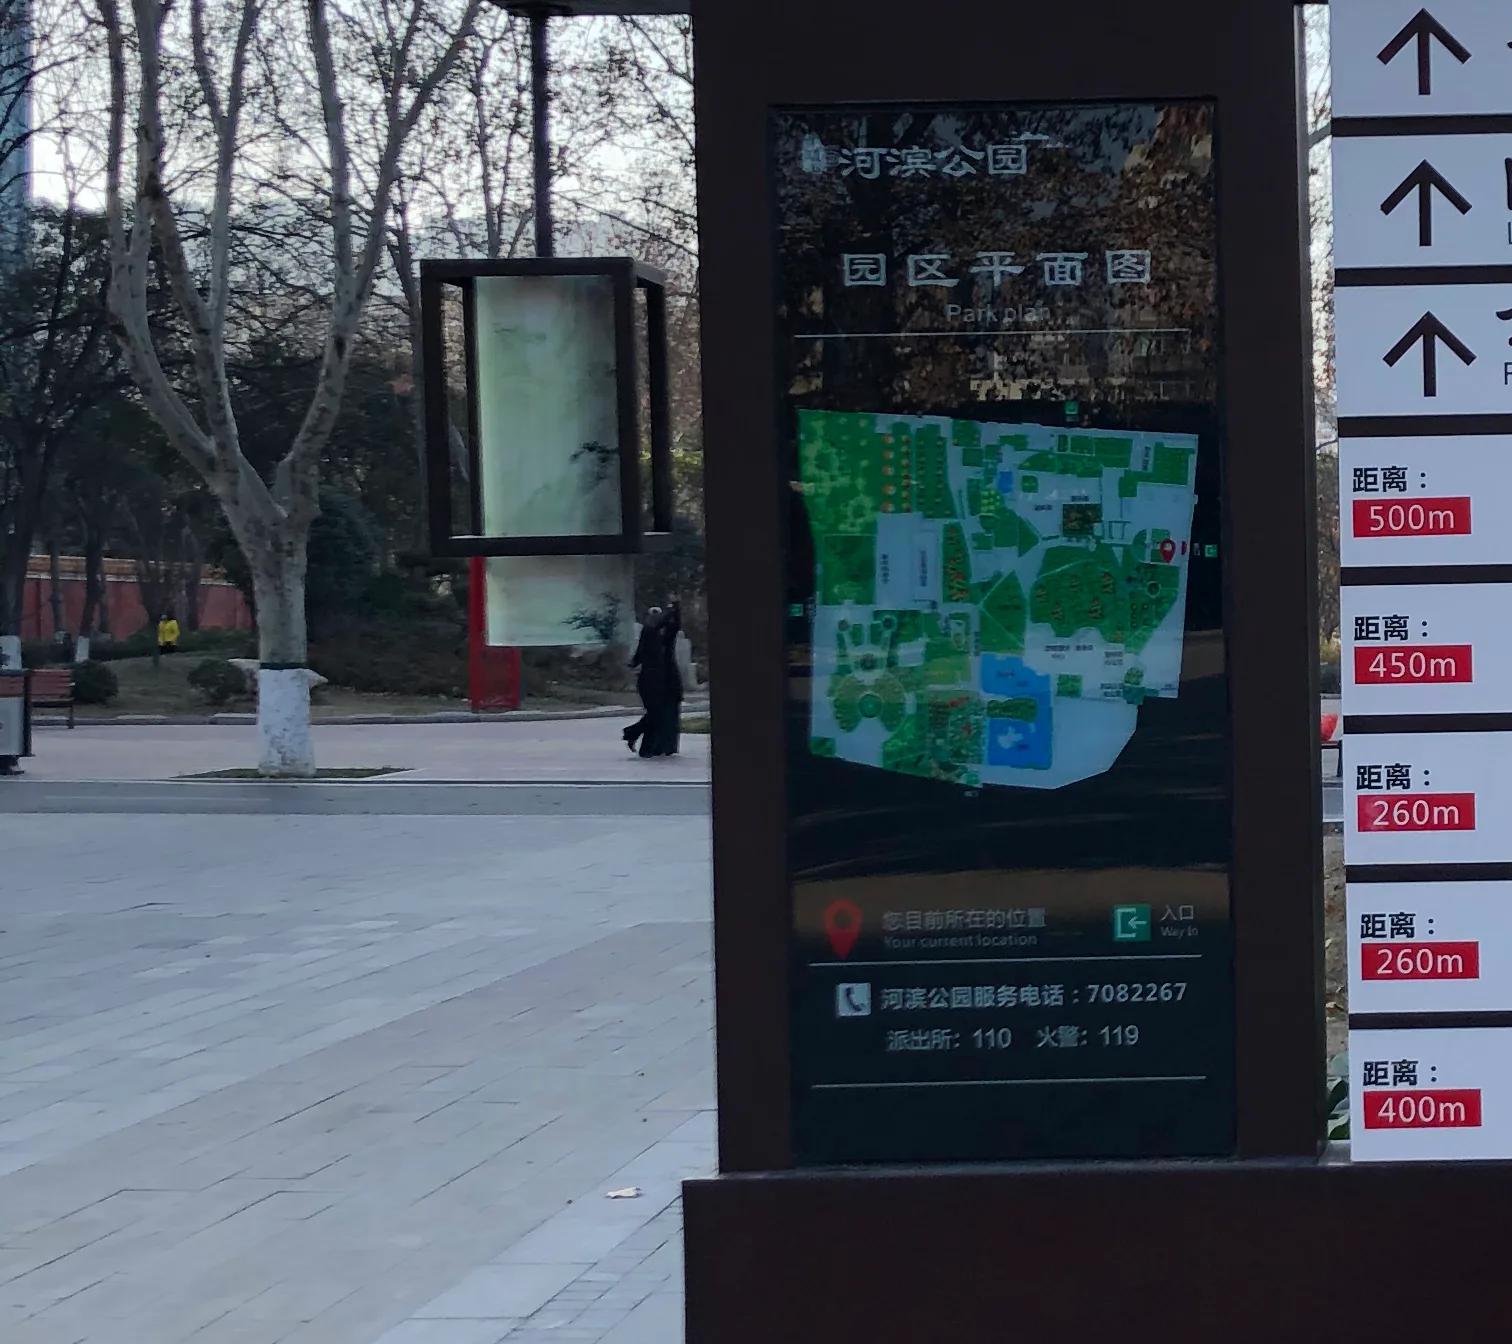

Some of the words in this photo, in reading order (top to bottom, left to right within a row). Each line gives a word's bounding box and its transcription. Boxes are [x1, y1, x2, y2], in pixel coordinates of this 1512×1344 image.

[838, 144, 1028, 179] 河滨公园
[842, 249, 1152, 287] 园区平面图
[946, 304, 998, 323] Park
[1368, 502, 1456, 532] 500m
[1368, 651, 1456, 678] 450m
[1372, 799, 1459, 826] 260m
[1160, 905, 1195, 922] 入口
[1376, 946, 1464, 975] 260m
[972, 1027, 1012, 1049] 110
[1100, 1025, 1140, 1047] 119
[1377, 1094, 1466, 1123] 400m
